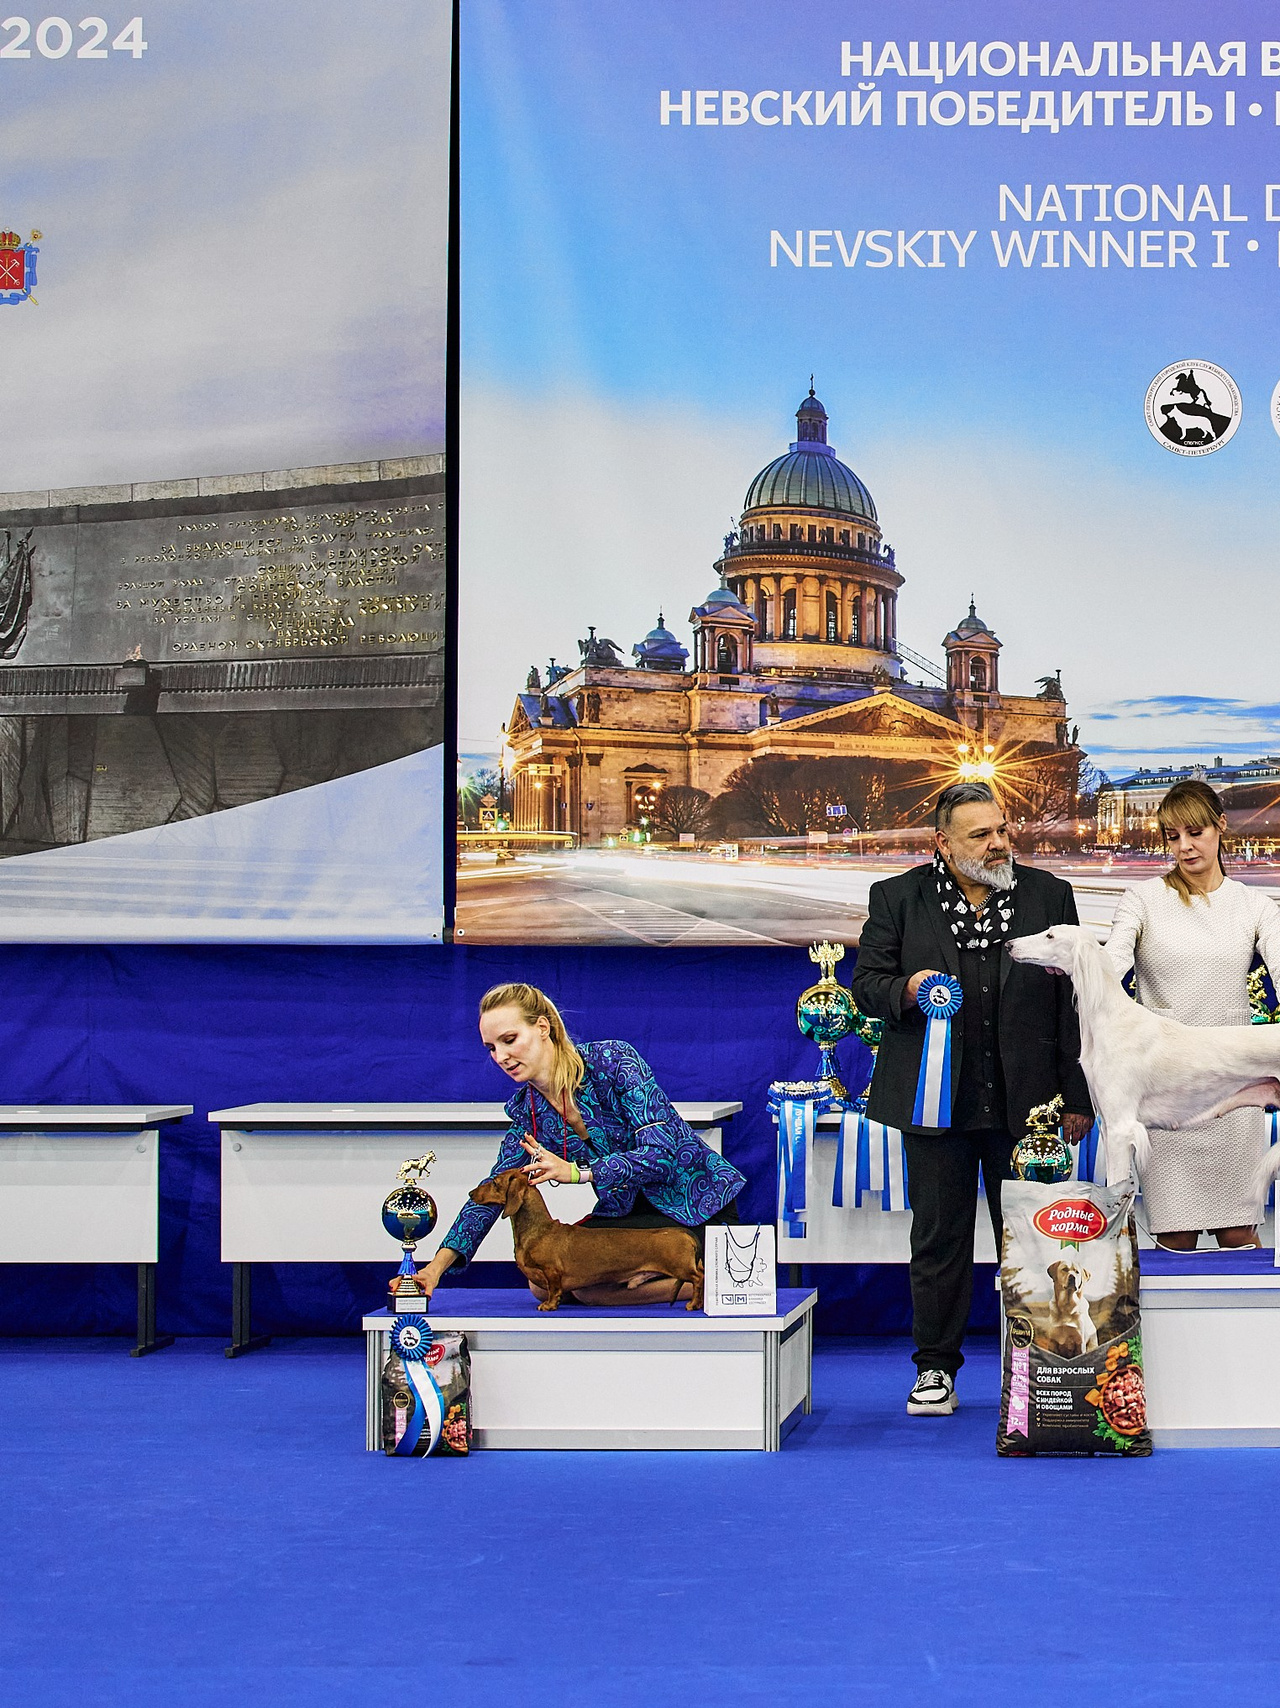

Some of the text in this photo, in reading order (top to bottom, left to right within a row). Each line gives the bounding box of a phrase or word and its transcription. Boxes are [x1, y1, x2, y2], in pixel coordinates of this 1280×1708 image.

[0, 16, 148, 59] 2024
[840, 41, 1247, 84] НАЦИОНАЛЬНАЯ
[659, 82, 883, 126] НЕВСКИЙ
[897, 90, 1213, 133] ПОБЕДИТЕЛЬ
[999, 184, 1248, 222] NATIONAL
[770, 230, 976, 268] NEVSKIY
[991, 230, 1197, 268] WINNER
[1211, 230, 1230, 268] I
[1048, 1206, 1095, 1221] Родные
[1050, 1221, 1089, 1234] корма
[1037, 1367, 1052, 1375] ДЛЯ
